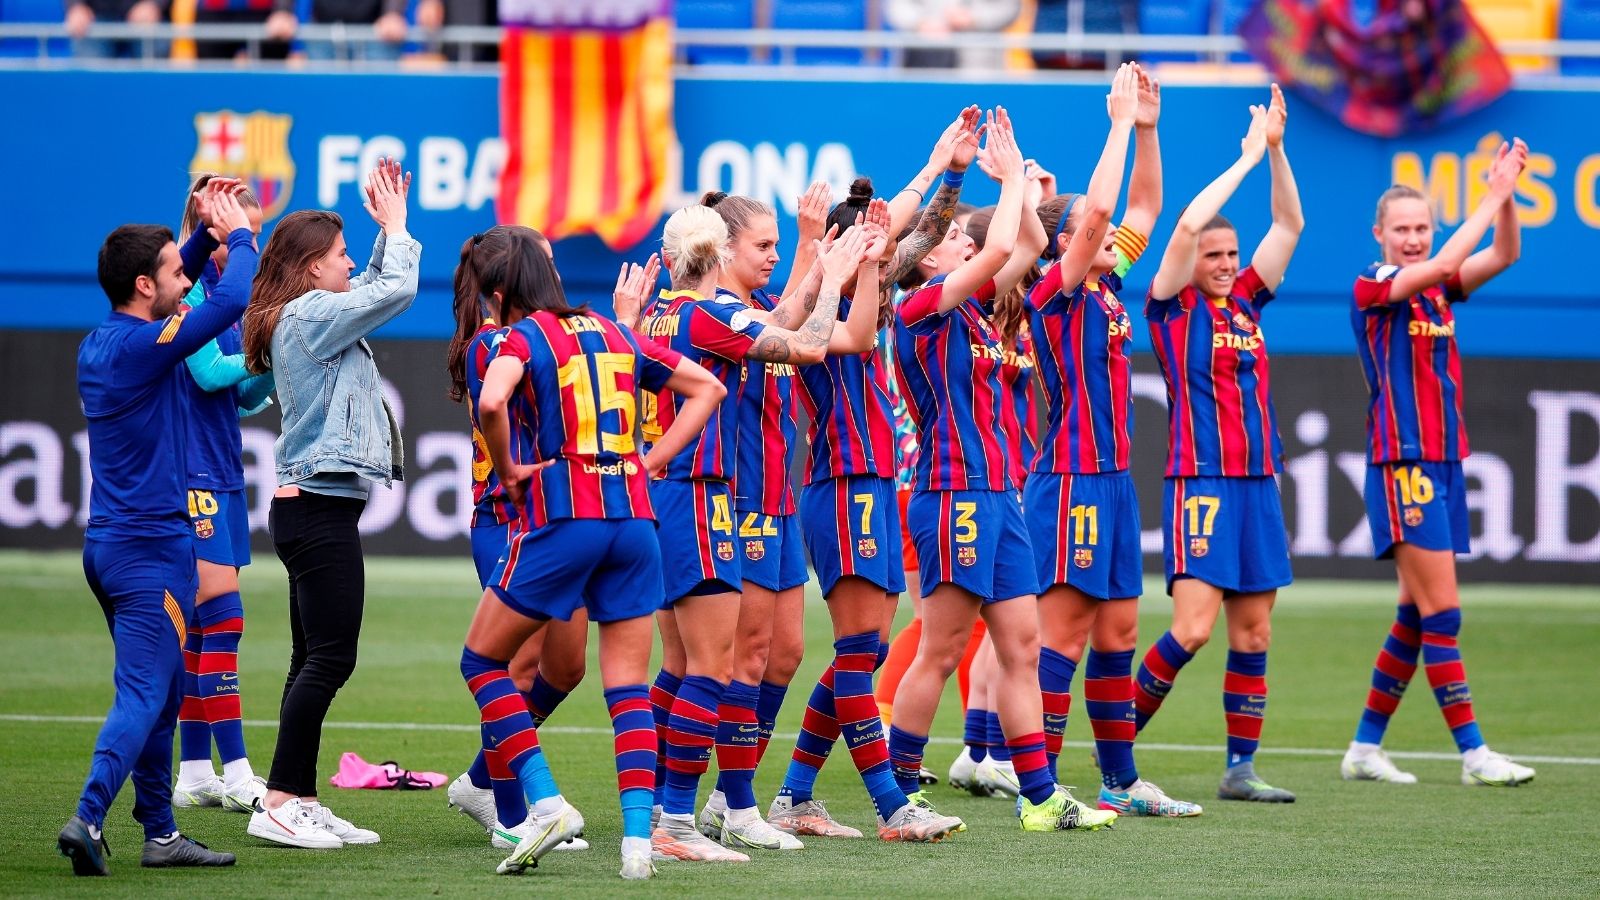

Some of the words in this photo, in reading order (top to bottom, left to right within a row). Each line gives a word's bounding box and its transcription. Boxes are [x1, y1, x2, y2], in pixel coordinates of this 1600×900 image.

[318, 134, 407, 208] FC
[558, 353, 636, 455] 15
[583, 460, 623, 476] unicef
[1393, 465, 1434, 506] 16
[712, 494, 733, 536] 4
[854, 493, 874, 535] 7
[955, 502, 978, 543] 3
[1070, 505, 1098, 546] 11
[1184, 496, 1220, 536] 17
